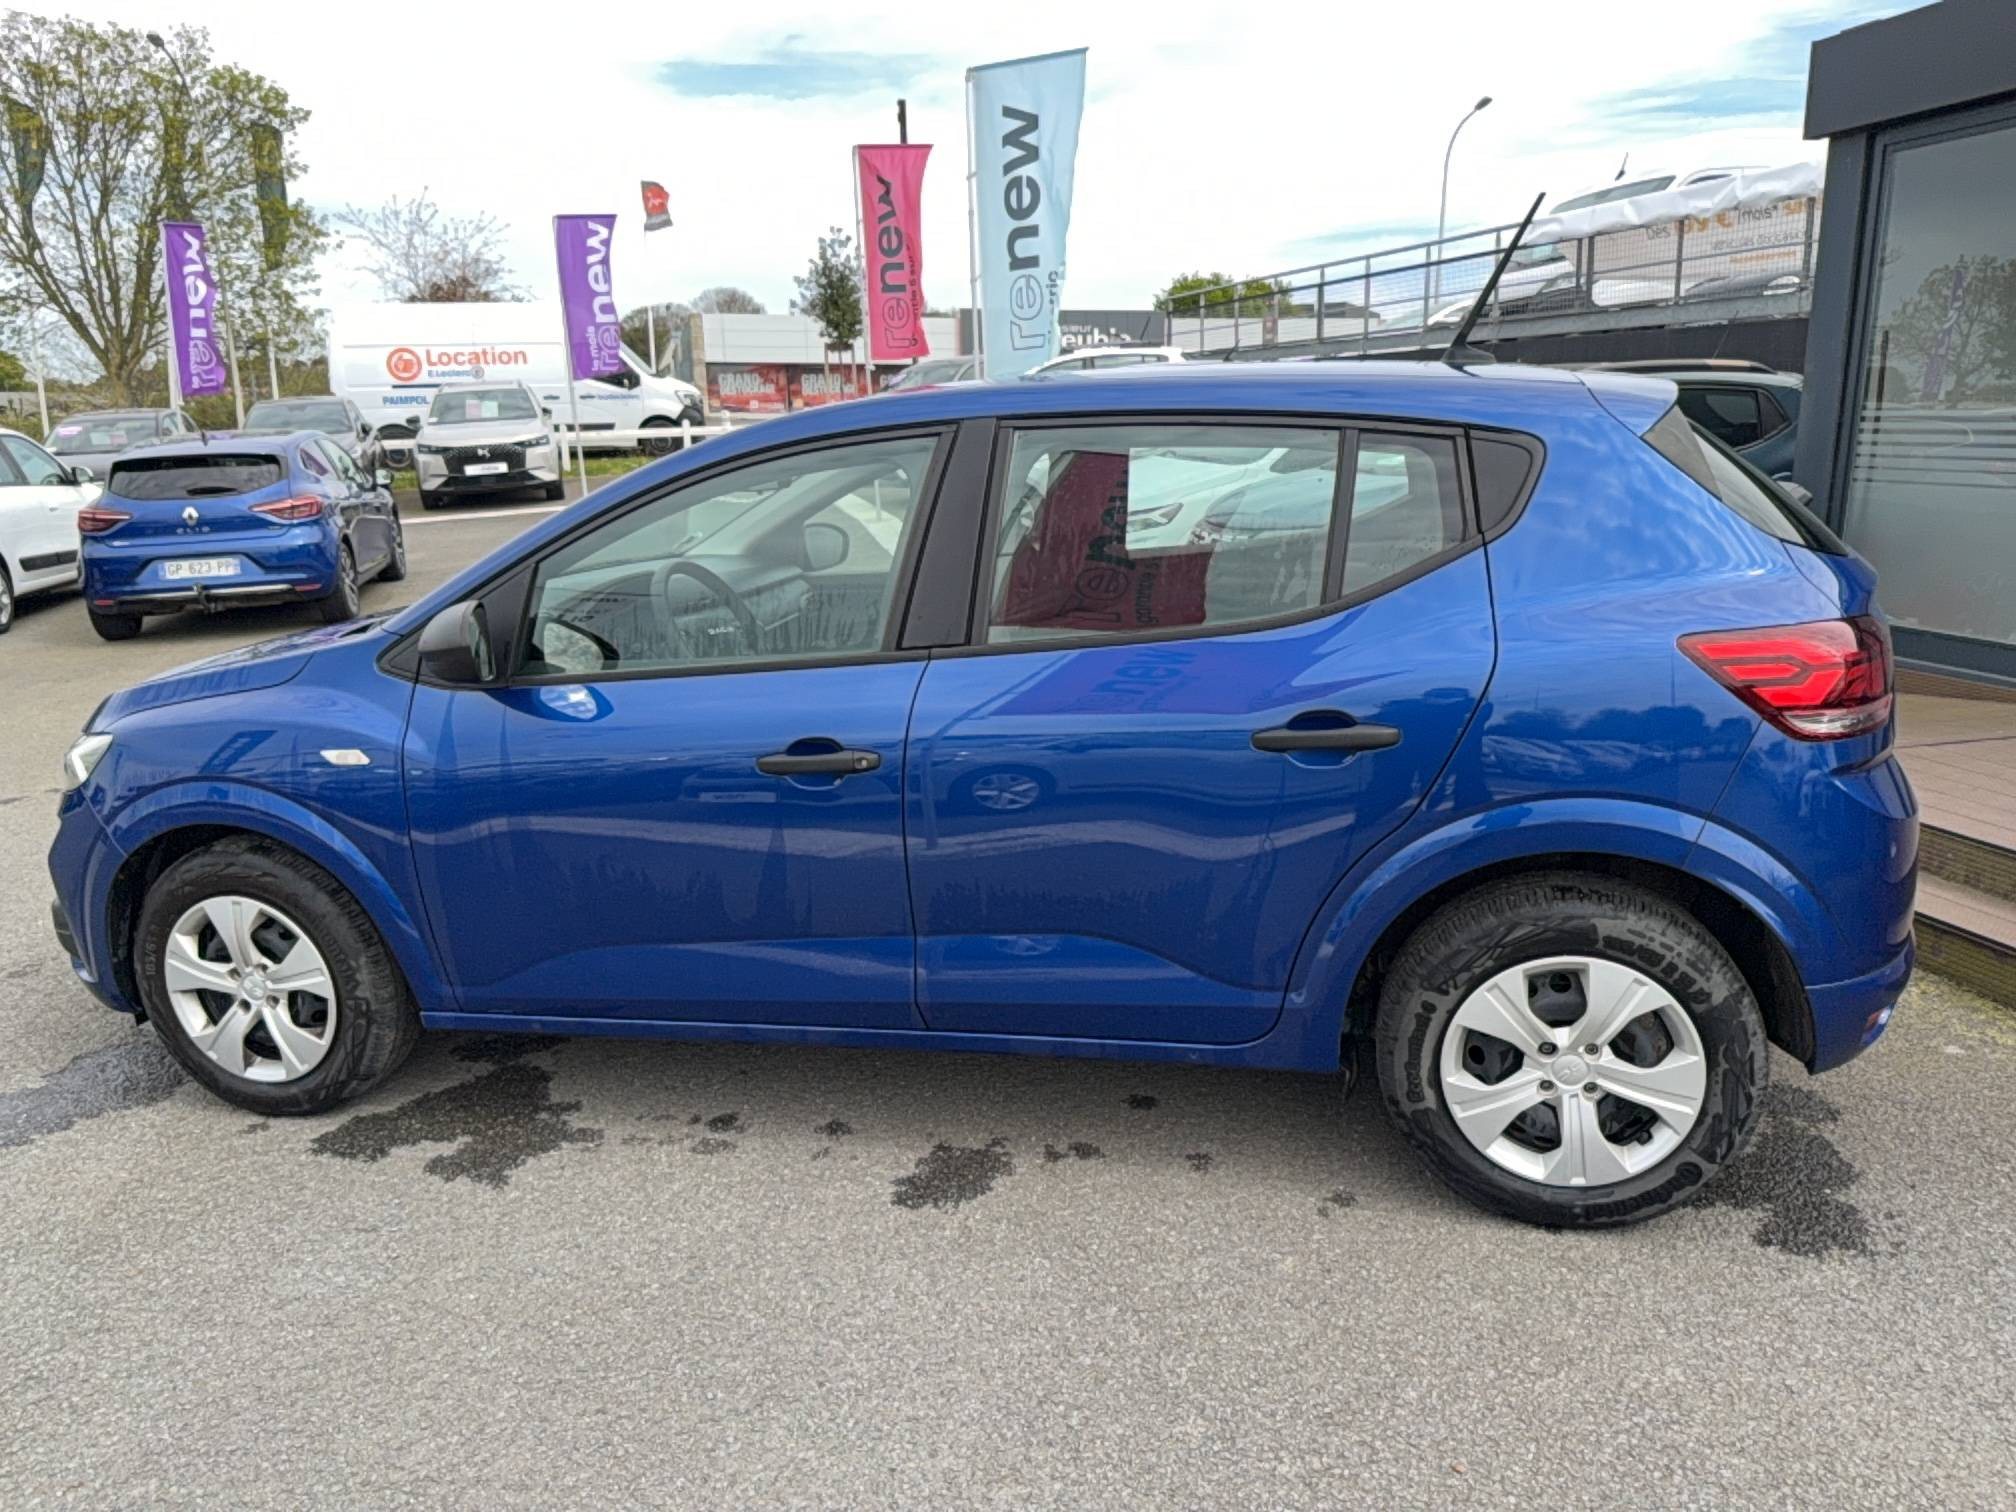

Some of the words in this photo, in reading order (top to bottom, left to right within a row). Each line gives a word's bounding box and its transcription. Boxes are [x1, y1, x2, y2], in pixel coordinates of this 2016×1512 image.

[586, 220, 621, 371] renew
[876, 173, 911, 349] renew
[1001, 104, 1046, 351] renew
[425, 346, 528, 367] Location
